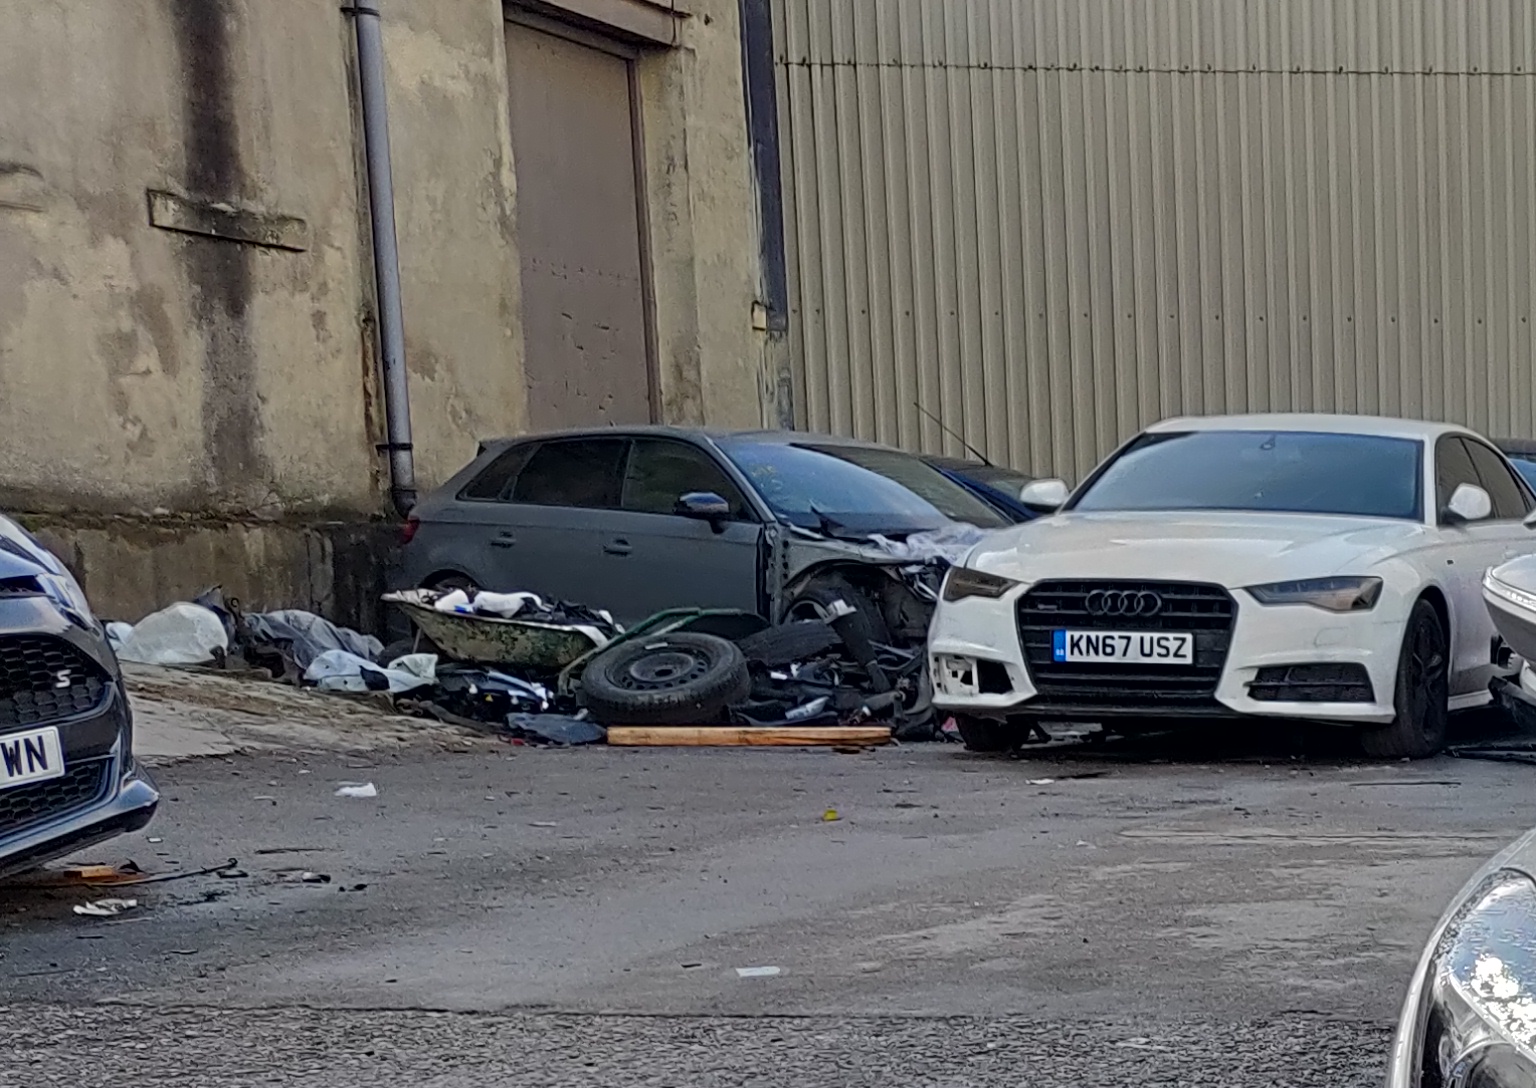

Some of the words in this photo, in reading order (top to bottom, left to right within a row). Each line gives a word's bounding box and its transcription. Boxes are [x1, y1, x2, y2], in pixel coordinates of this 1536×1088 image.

[1069, 634, 1131, 658] KN67
[1140, 635, 1188, 659] USZ
[0, 735, 49, 778] WN
